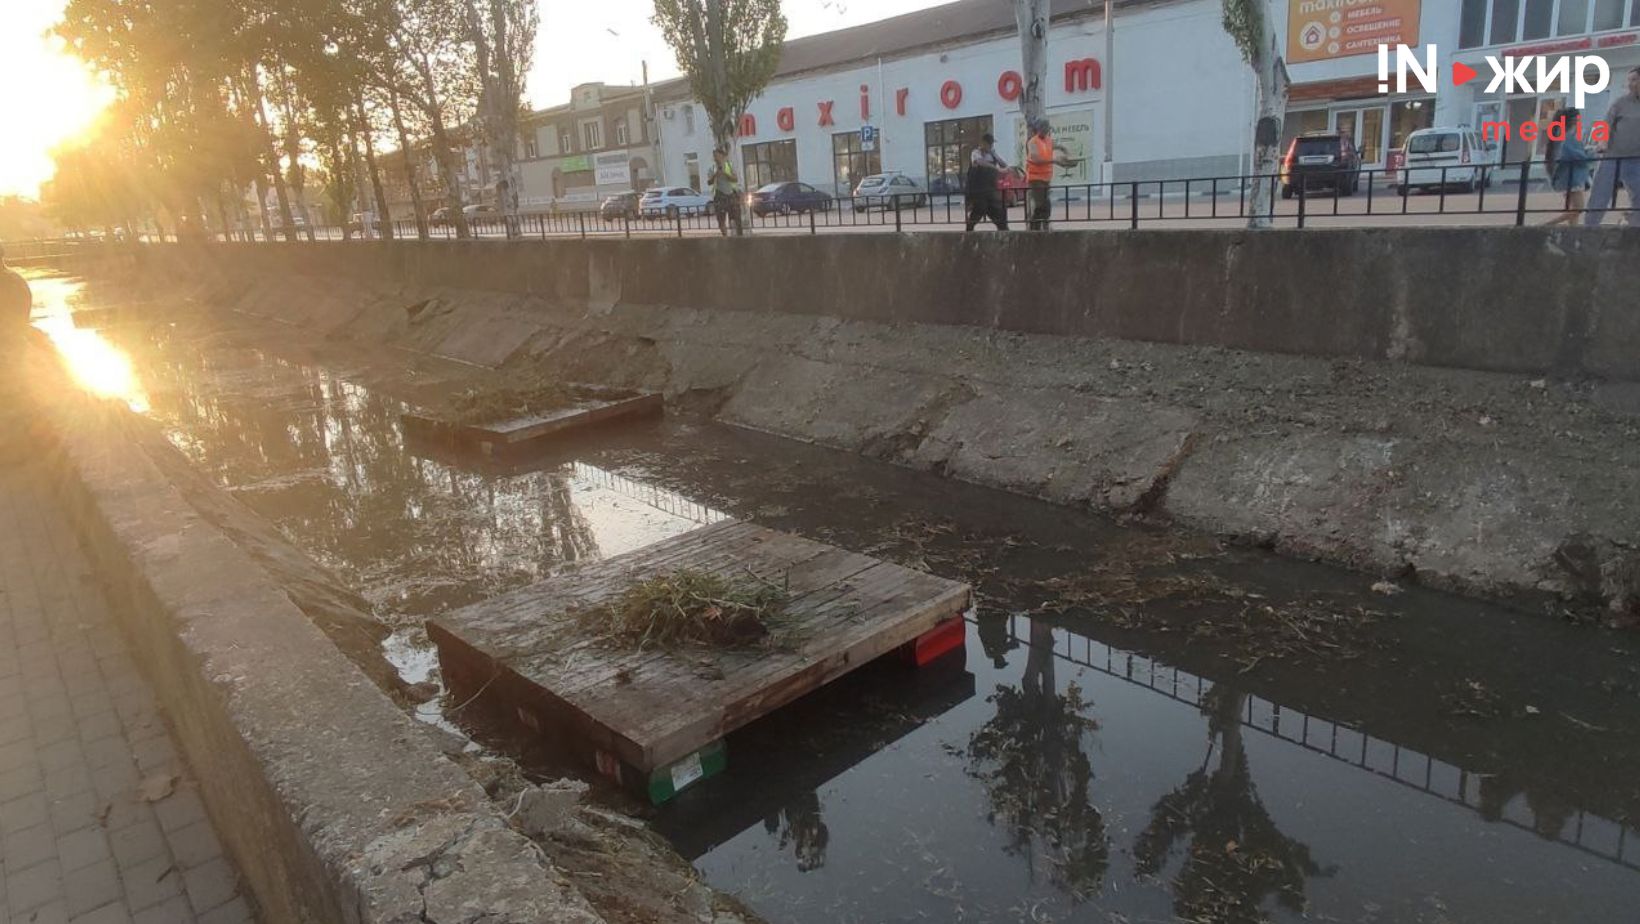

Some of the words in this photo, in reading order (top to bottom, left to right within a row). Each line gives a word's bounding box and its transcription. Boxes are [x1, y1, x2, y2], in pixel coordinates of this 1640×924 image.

[1347, 6, 1383, 19] МЕБЕЛЬ
[1346, 18, 1401, 34] ОСВЕЩЕНИЕ
[1345, 34, 1402, 50] САНТЕХНИКА
[736, 57, 1102, 138] maxiroom
